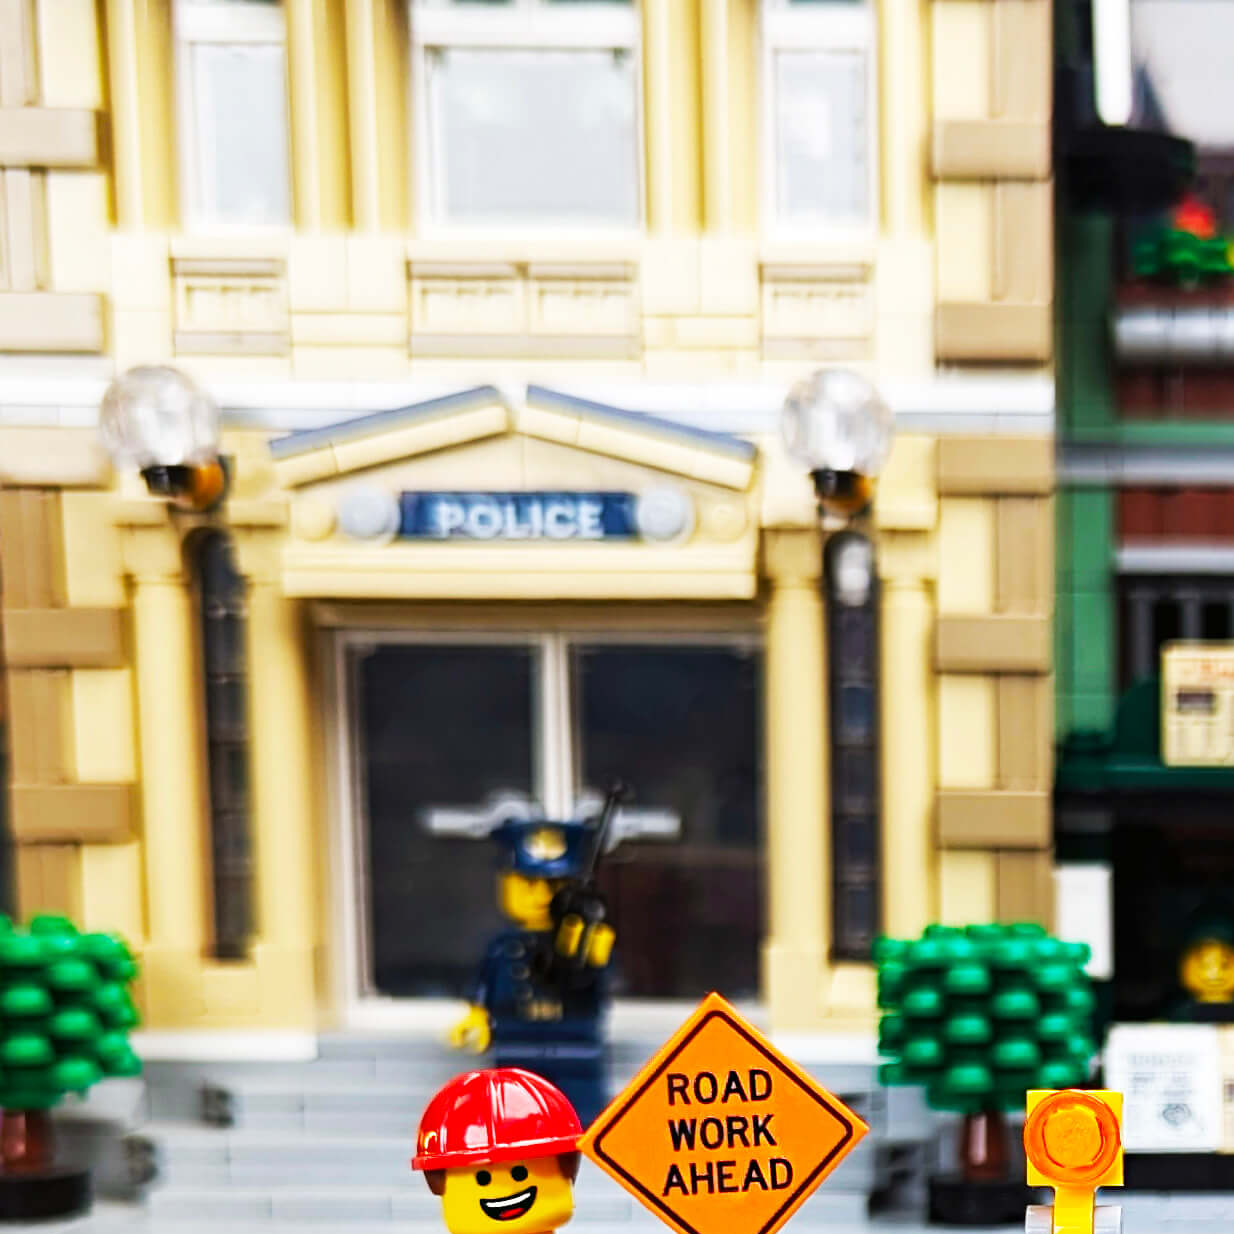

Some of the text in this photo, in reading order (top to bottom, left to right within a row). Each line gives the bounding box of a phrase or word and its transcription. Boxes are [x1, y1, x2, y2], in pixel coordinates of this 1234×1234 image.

[436, 500, 605, 539] POLICE
[666, 1069, 773, 1106] ROAD
[667, 1114, 777, 1152] WORK
[661, 1157, 794, 1197] AHEAD
